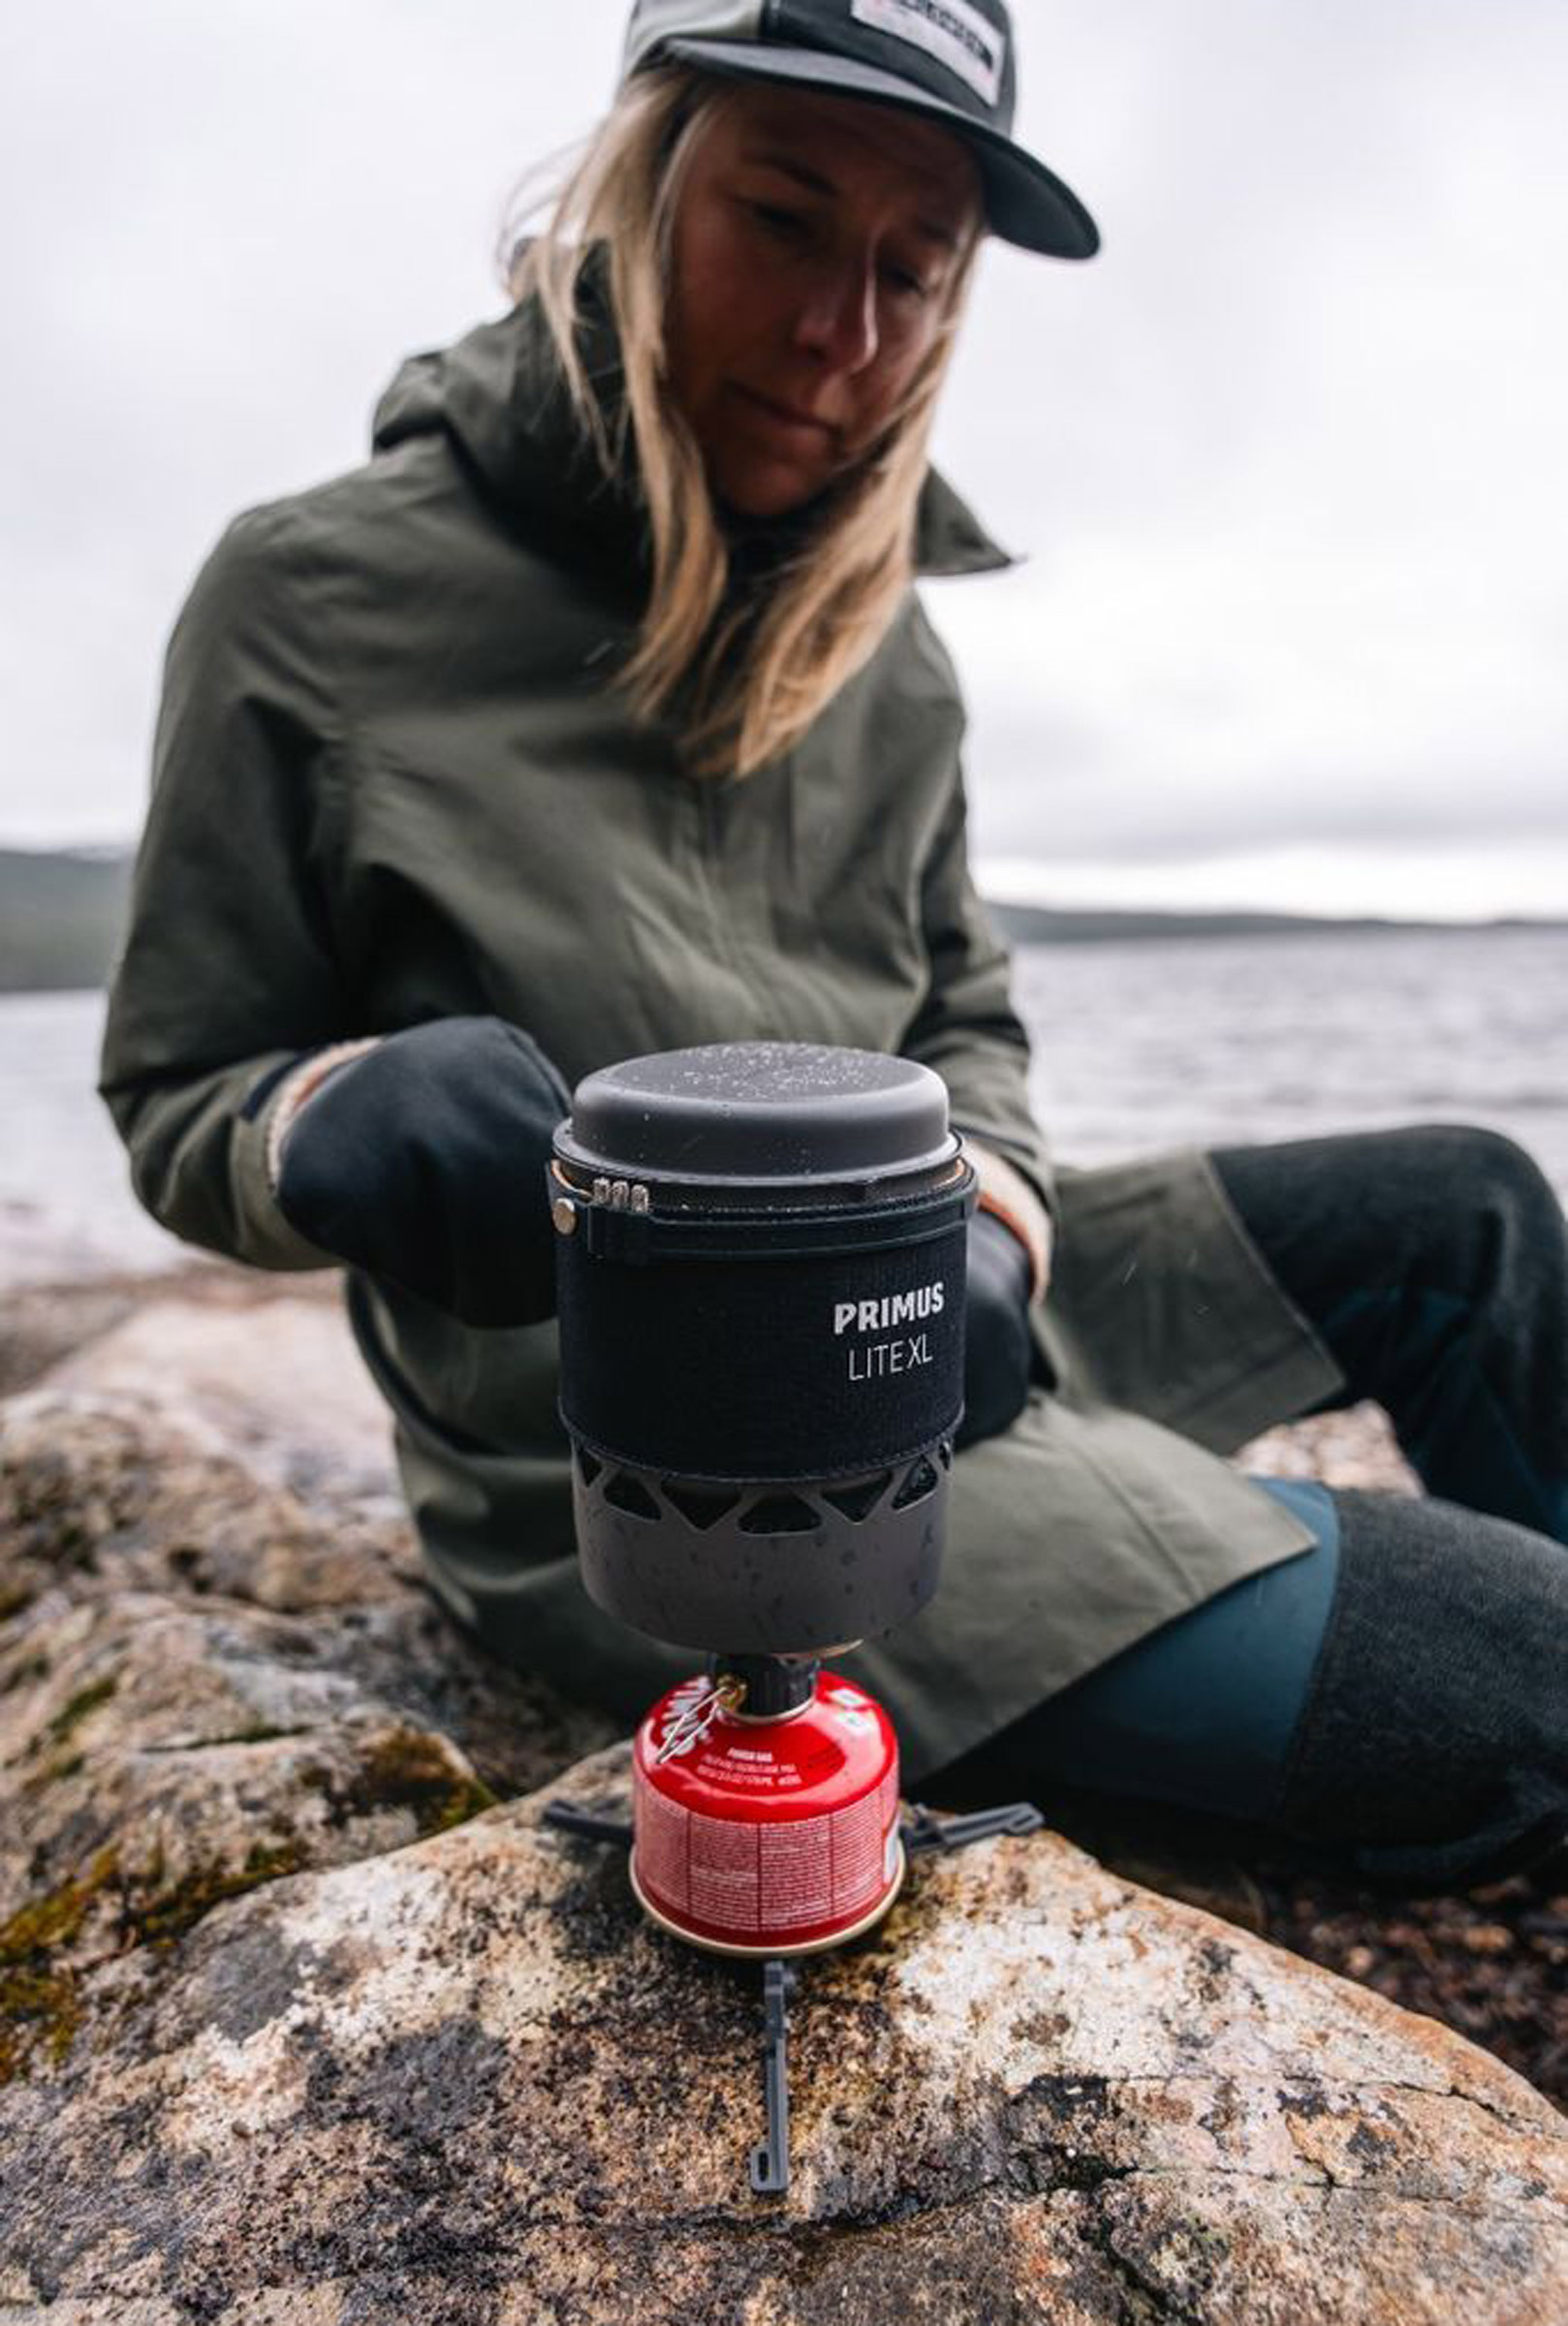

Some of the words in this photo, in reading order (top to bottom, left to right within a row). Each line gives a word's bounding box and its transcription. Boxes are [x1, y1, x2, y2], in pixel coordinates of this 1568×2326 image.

[834, 1281, 945, 1335] PRIMUS
[849, 1339, 904, 1380] LITE
[906, 1333, 932, 1369] XL
